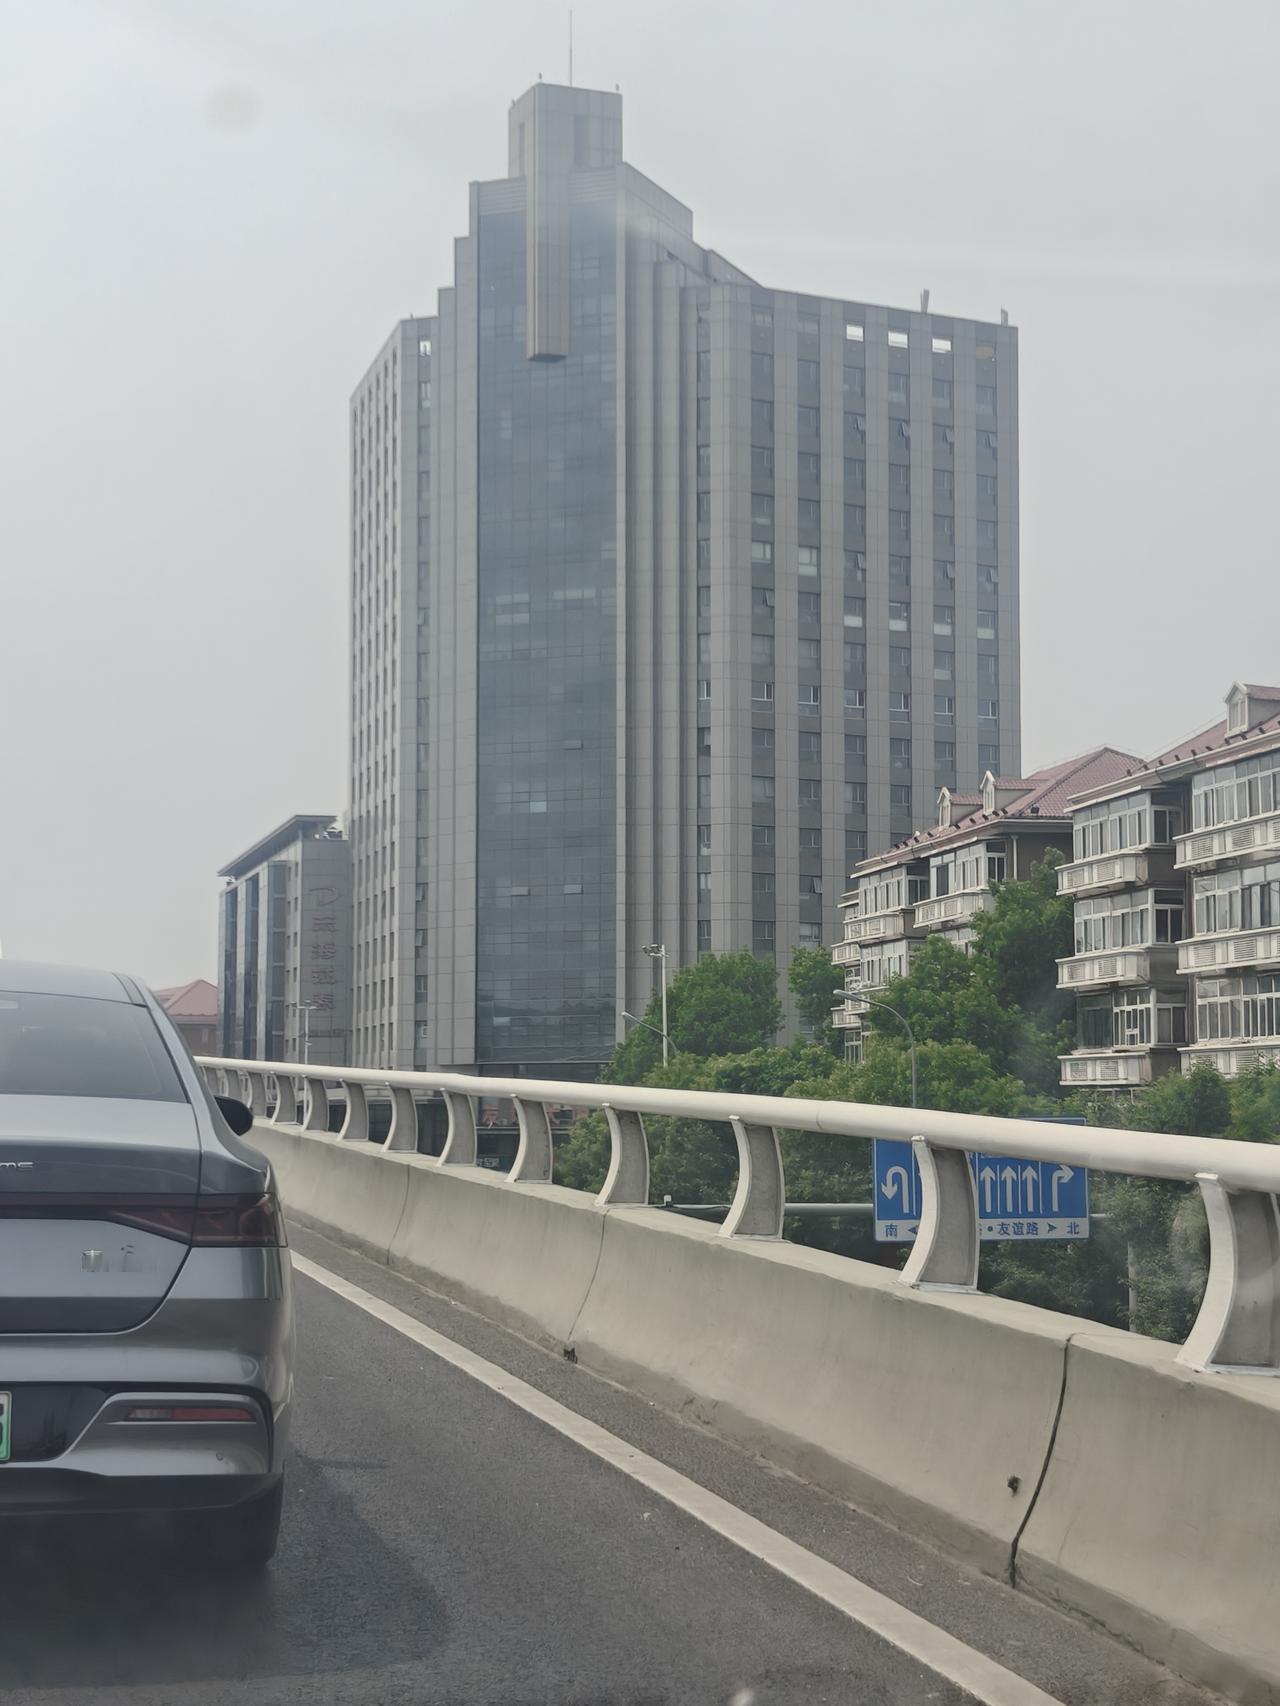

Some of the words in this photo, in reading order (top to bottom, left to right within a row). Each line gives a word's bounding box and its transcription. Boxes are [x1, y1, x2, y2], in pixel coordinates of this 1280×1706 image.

[885, 1224, 898, 1238] 南
[997, 1222, 1039, 1236] 友谊路
[1067, 1221, 1080, 1235] 北
